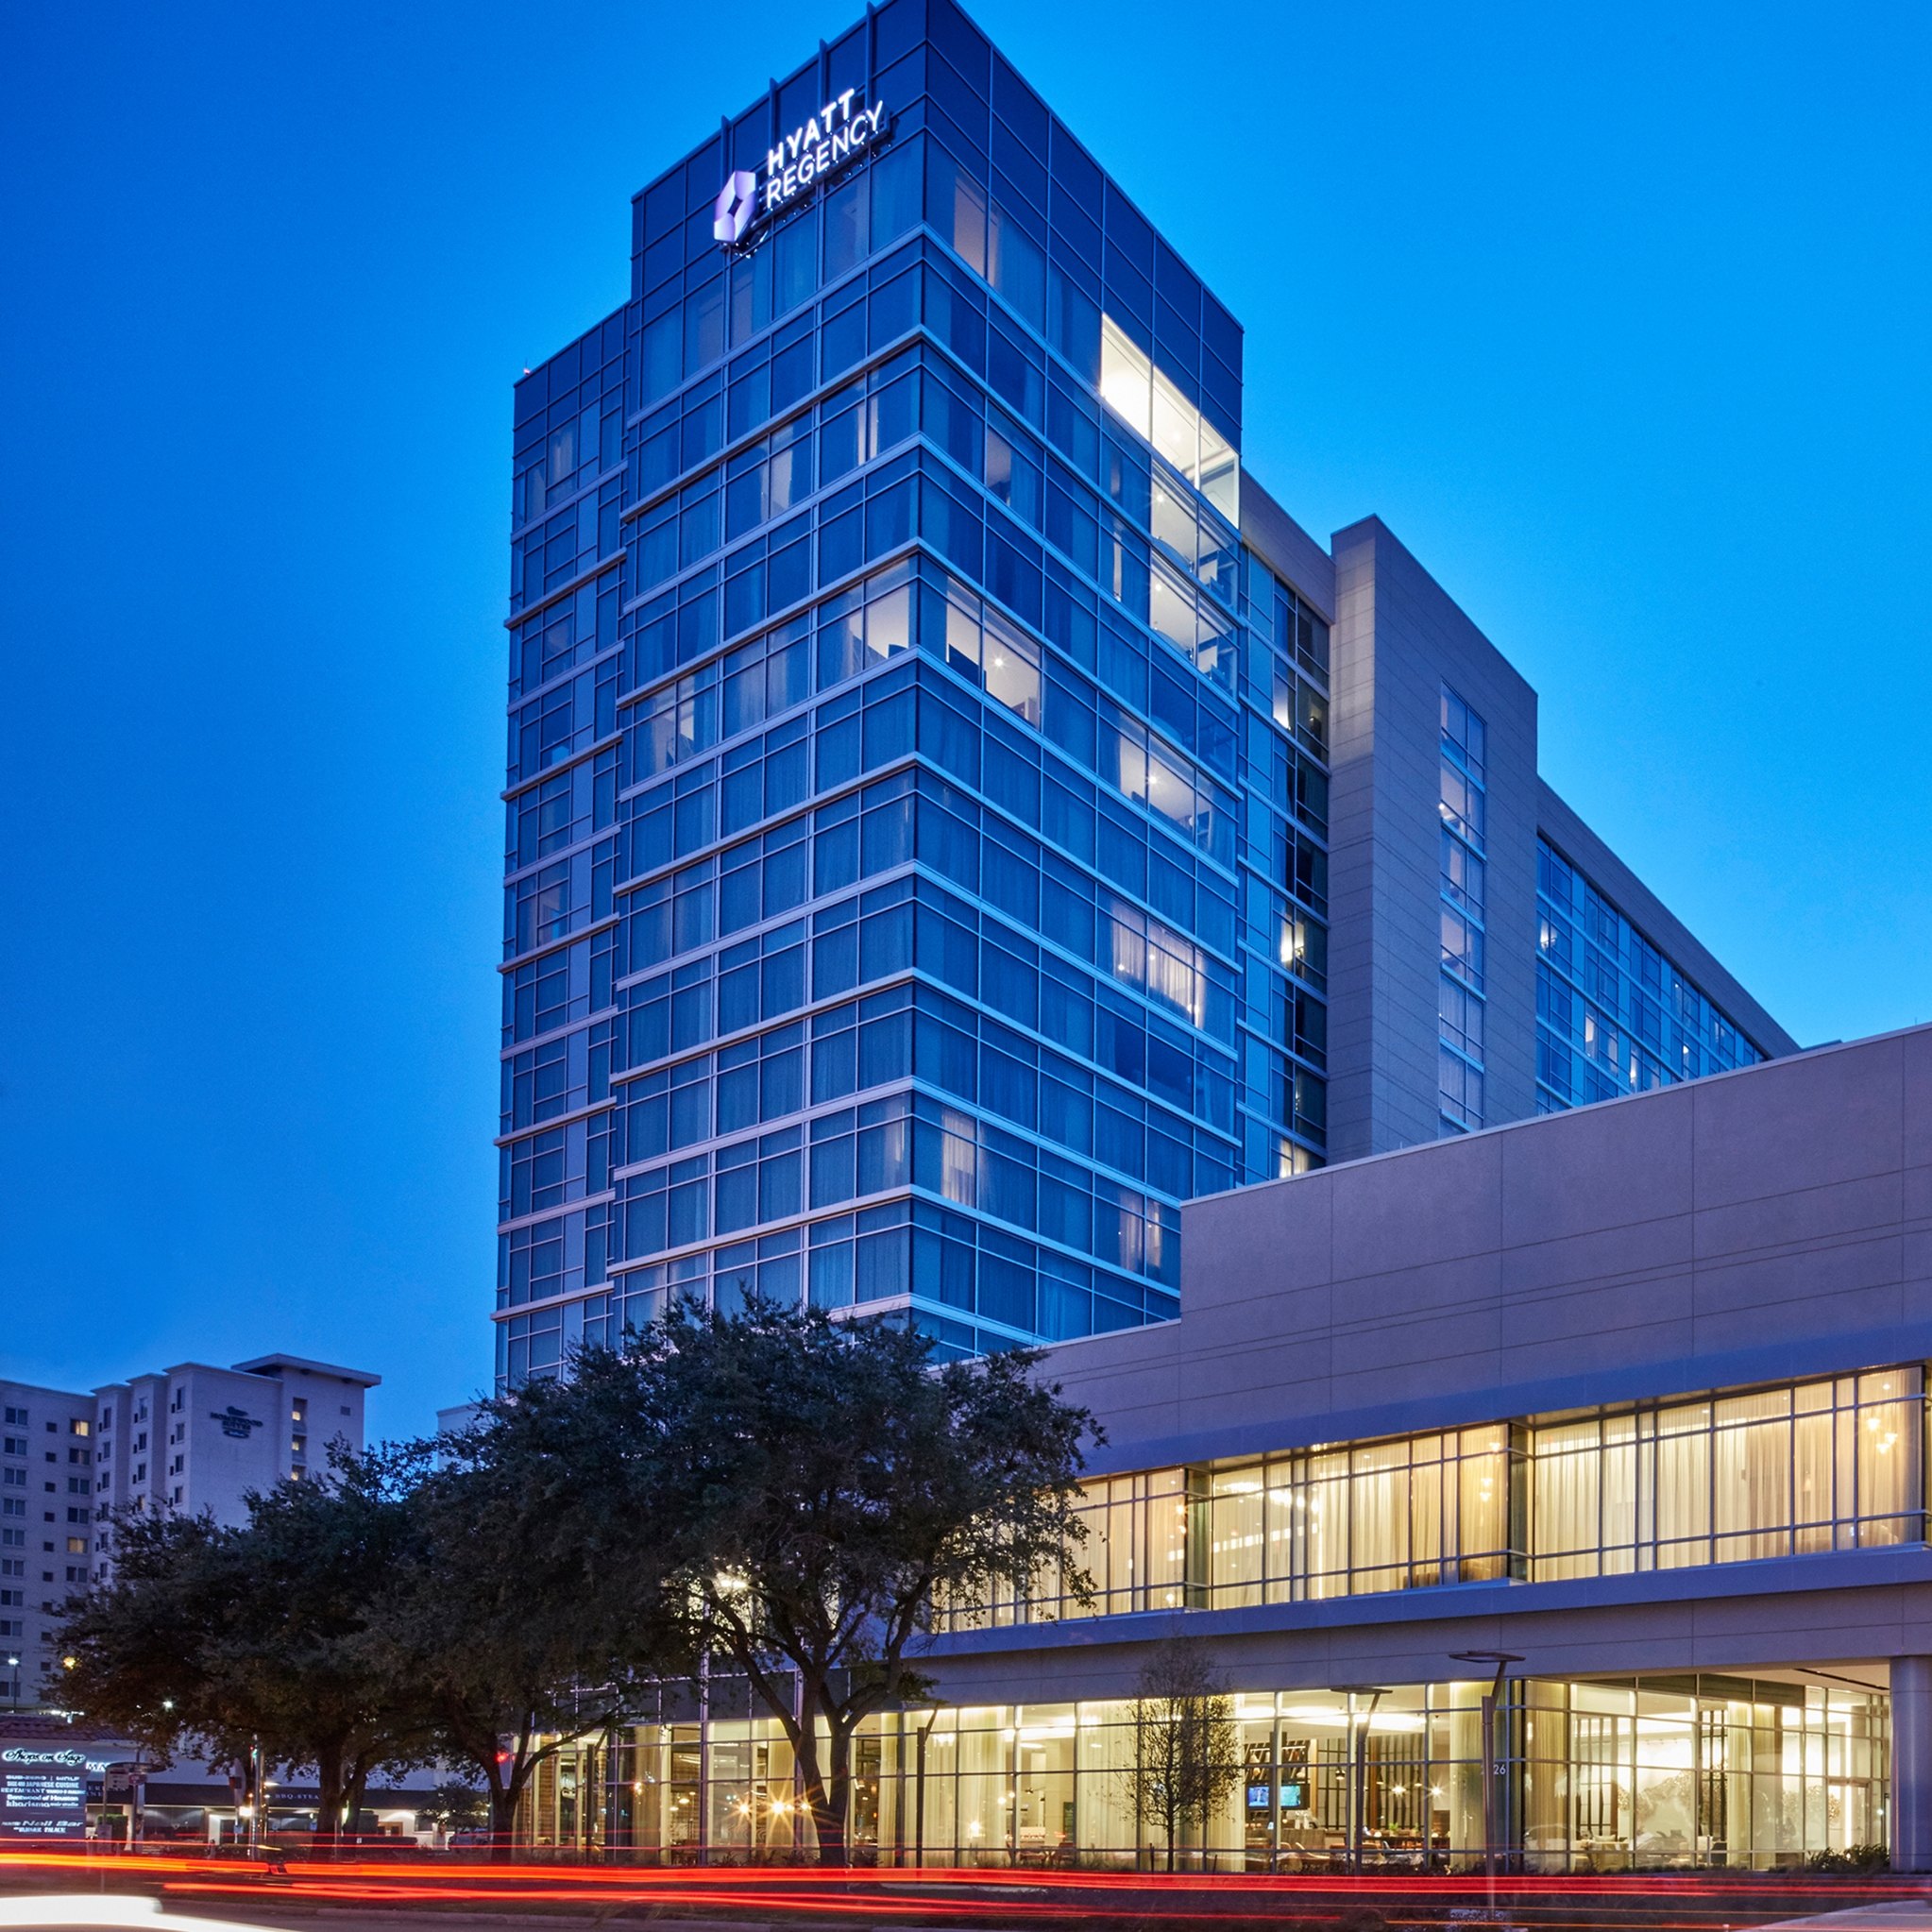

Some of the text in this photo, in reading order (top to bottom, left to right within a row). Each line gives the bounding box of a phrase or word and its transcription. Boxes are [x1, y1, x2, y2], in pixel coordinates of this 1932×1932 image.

[766, 100, 883, 209] REGENCY
[767, 88, 855, 176] HYATT
[3, 1748, 86, 1767] Shops on Sage
